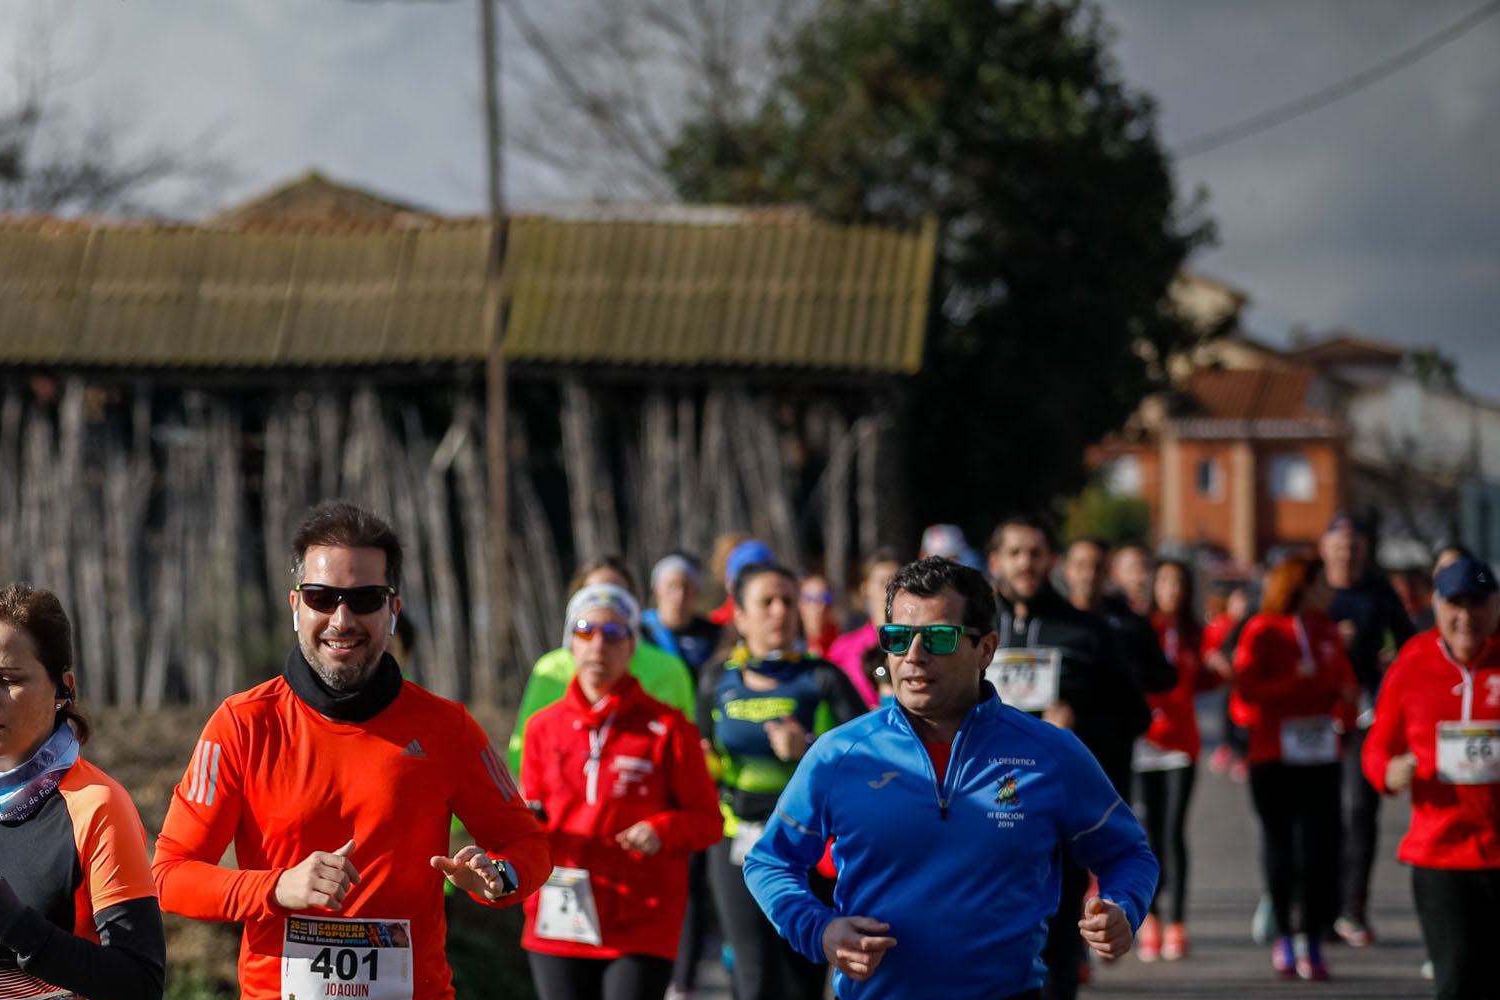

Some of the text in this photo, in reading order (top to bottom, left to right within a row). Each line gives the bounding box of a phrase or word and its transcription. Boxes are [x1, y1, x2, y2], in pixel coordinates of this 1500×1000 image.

[318, 923, 365, 932] CARRERA
[318, 930, 365, 938] POPULAR
[310, 947, 378, 981] 401
[325, 983, 369, 997] JOAQUIN
